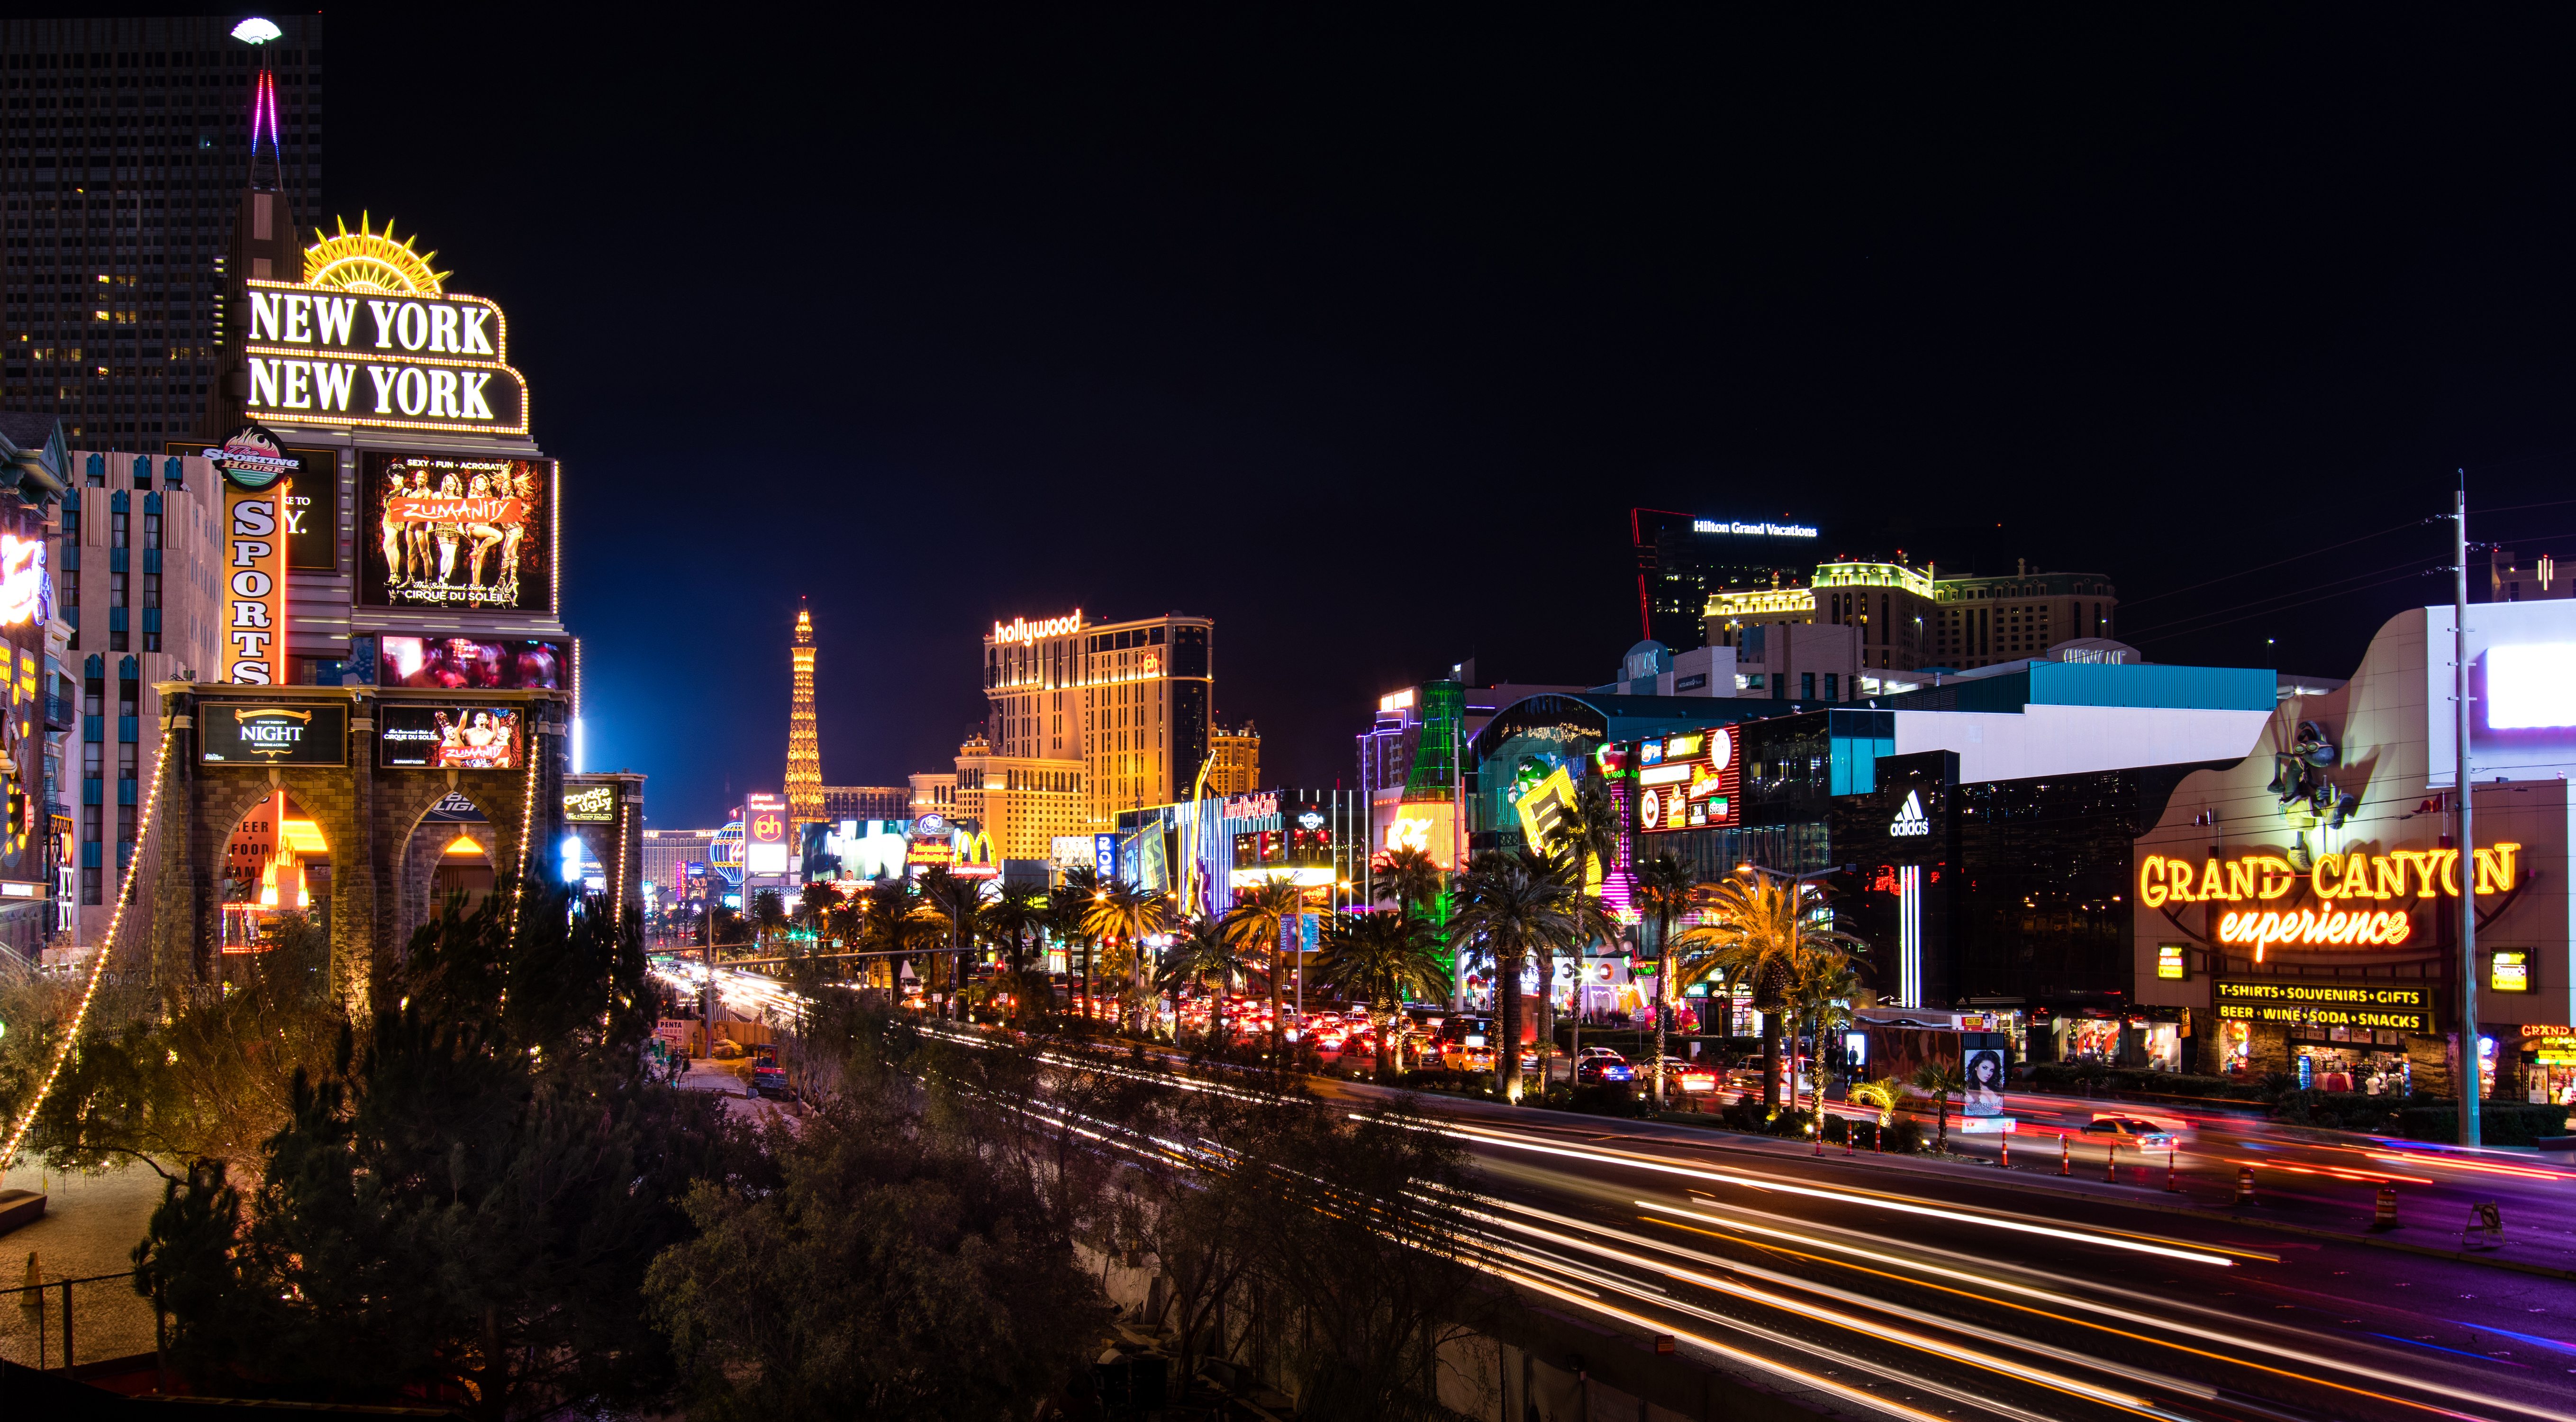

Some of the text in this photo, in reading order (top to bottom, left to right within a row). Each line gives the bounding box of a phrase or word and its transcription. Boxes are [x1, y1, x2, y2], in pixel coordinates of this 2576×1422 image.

[249, 292, 494, 355] NEW YORK
[248, 358, 493, 419] NEW YORK
[202, 448, 299, 467] SPORTING
[228, 445, 260, 456] The
[222, 460, 285, 474] HOUSE
[460, 462, 508, 471] ACROBATIC
[295, 497, 310, 505] TO
[404, 499, 510, 522] ZUMANITY
[1694, 520, 1817, 537] Hilton Grand Vacations
[232, 500, 276, 685] SPORTS
[413, 581, 429, 589] The
[430, 582, 467, 591] Sensual
[488, 585, 498, 593] of
[405, 590, 446, 602] CIRQUE
[450, 592, 465, 601] DU
[996, 609, 1079, 647] hollywood
[240, 726, 304, 741] NIGHT
[445, 746, 504, 758] ZUMANITY
[1667, 734, 1703, 757] SUBWAY
[563, 788, 610, 805] coyote
[578, 797, 612, 812] ugly
[1223, 793, 1277, 821] Hard Rock Cafe
[1694, 805, 1702, 816] 24
[1709, 802, 1727, 814] sbarro
[236, 821, 269, 832] EER
[757, 815, 782, 838] ph
[1890, 820, 1928, 836] adidas
[231, 844, 269, 856] FOOD
[1099, 837, 1112, 884] ROS
[225, 866, 262, 878] GAM
[2141, 843, 2522, 907] GRAND CANYON
[2220, 902, 2410, 963] experience
[2219, 984, 2420, 1004] T-SHIRTS SOUVENIRS GIFTS
[2220, 1006, 2420, 1028] BEER WINE SODA SNACKS
[2522, 1025, 2569, 1036] GRAND
